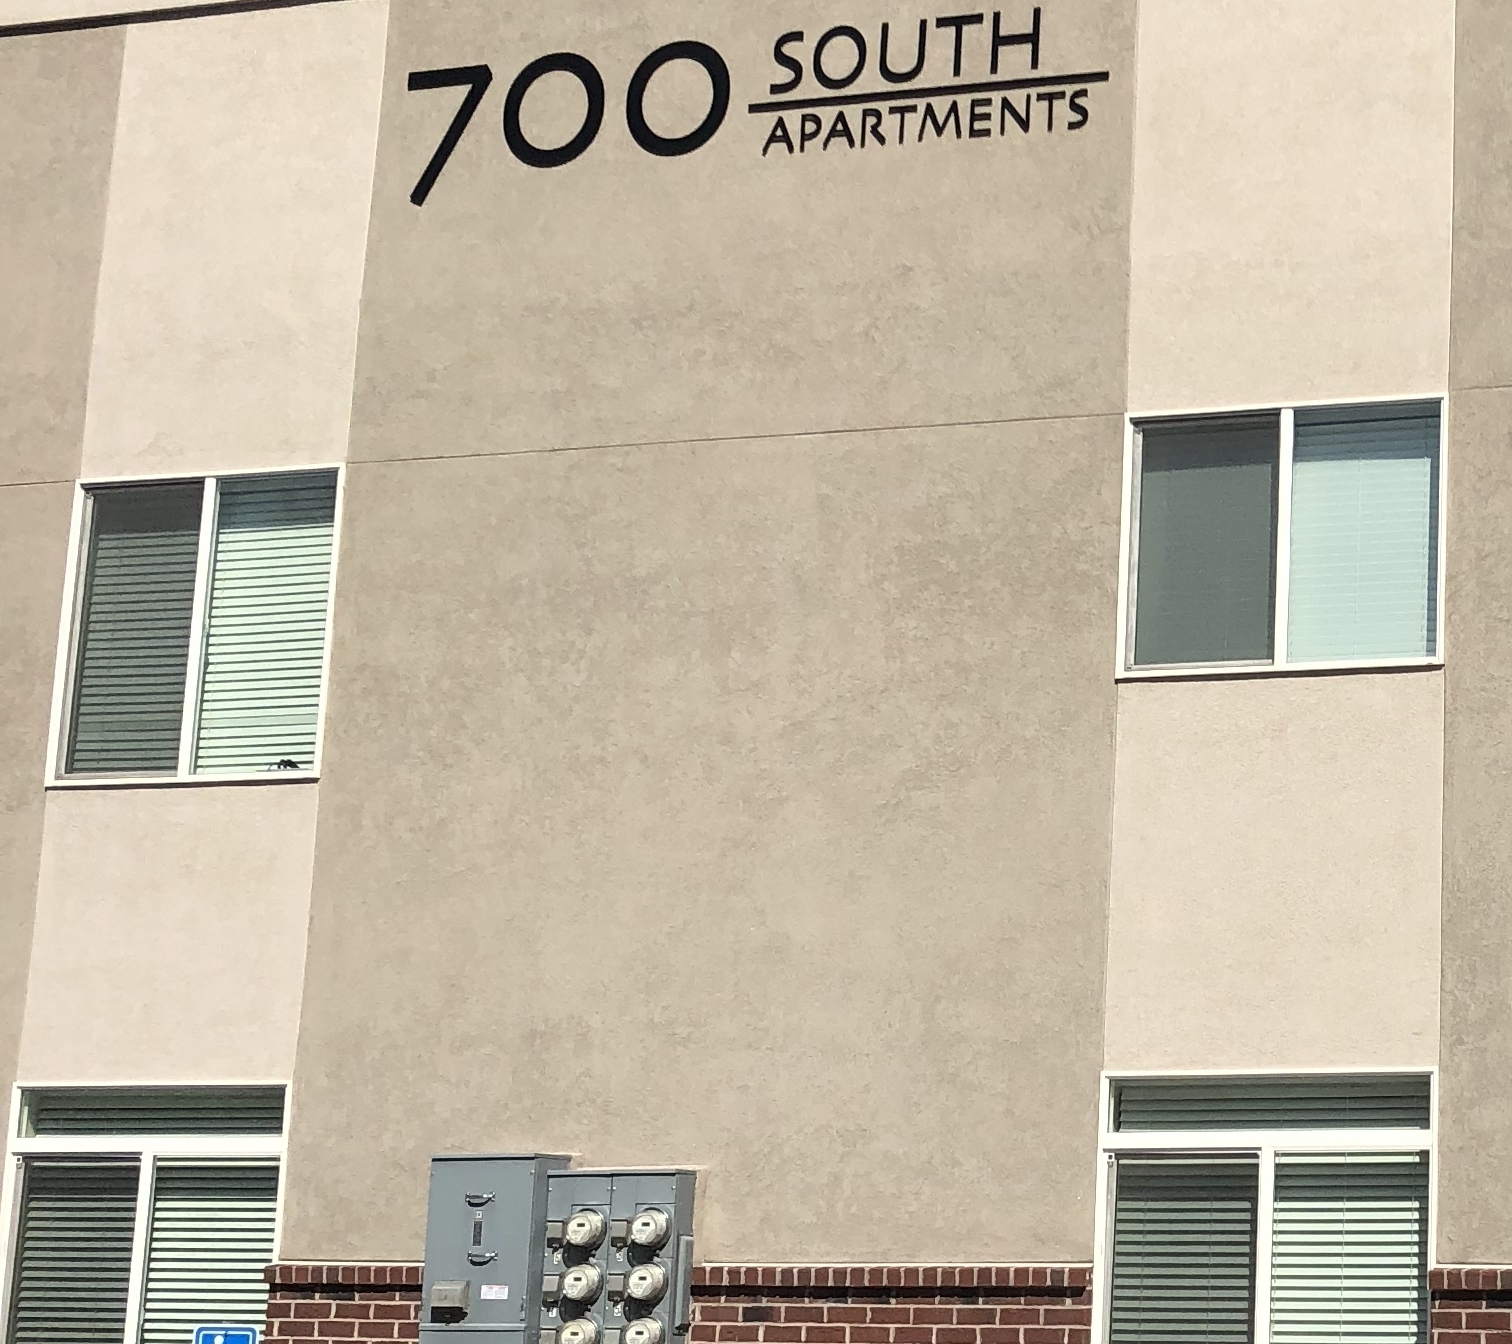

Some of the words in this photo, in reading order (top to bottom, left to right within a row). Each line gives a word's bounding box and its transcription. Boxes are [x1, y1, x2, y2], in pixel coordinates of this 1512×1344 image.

[408, 40, 731, 206] 700
[769, 7, 1042, 94] SOUTH
[761, 89, 1090, 156] APARTMENTS
